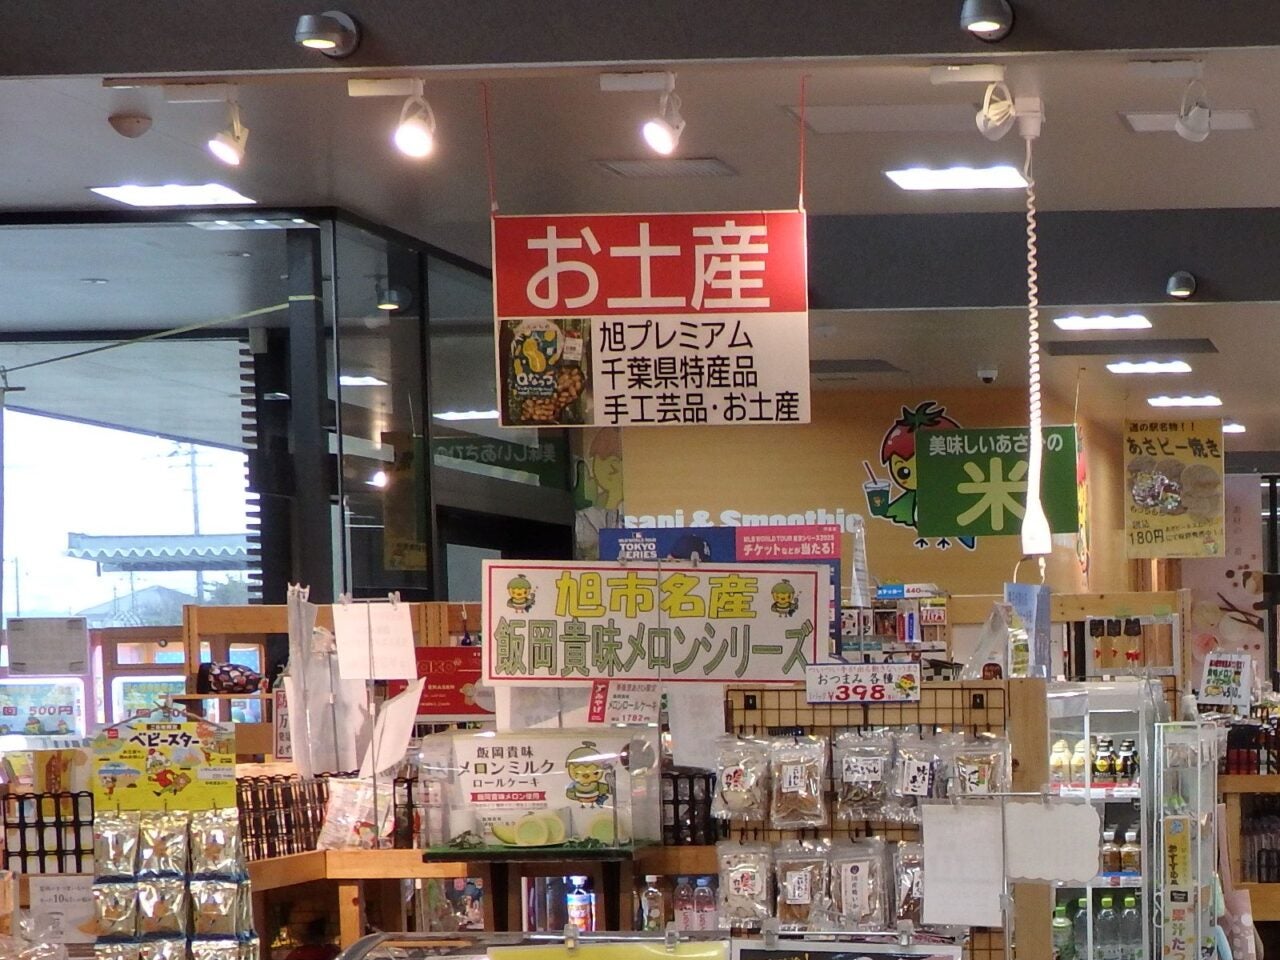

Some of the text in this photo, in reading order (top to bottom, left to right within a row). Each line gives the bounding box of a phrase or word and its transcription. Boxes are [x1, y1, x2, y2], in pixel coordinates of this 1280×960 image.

[526, 221, 770, 310] お土産
[600, 321, 753, 352] 旭プレミアム
[601, 356, 758, 390] 千葉県特産品
[604, 391, 799, 424] 手工芸品・お土産
[929, 433, 1064, 456] 美味しいあさの
[957, 457, 1030, 531] 米
[619, 543, 657, 551] TOKYO
[555, 570, 760, 619] 旭市名産
[494, 614, 815, 679] 飯岡貴味メロンシリーズ
[817, 673, 863, 686] おつまみ
[129, 732, 200, 748] ベビースター
[476, 746, 534, 758] 飯岡貴味
[457, 759, 555, 776] メロンミルク
[473, 778, 540, 788] ロールケーキ
